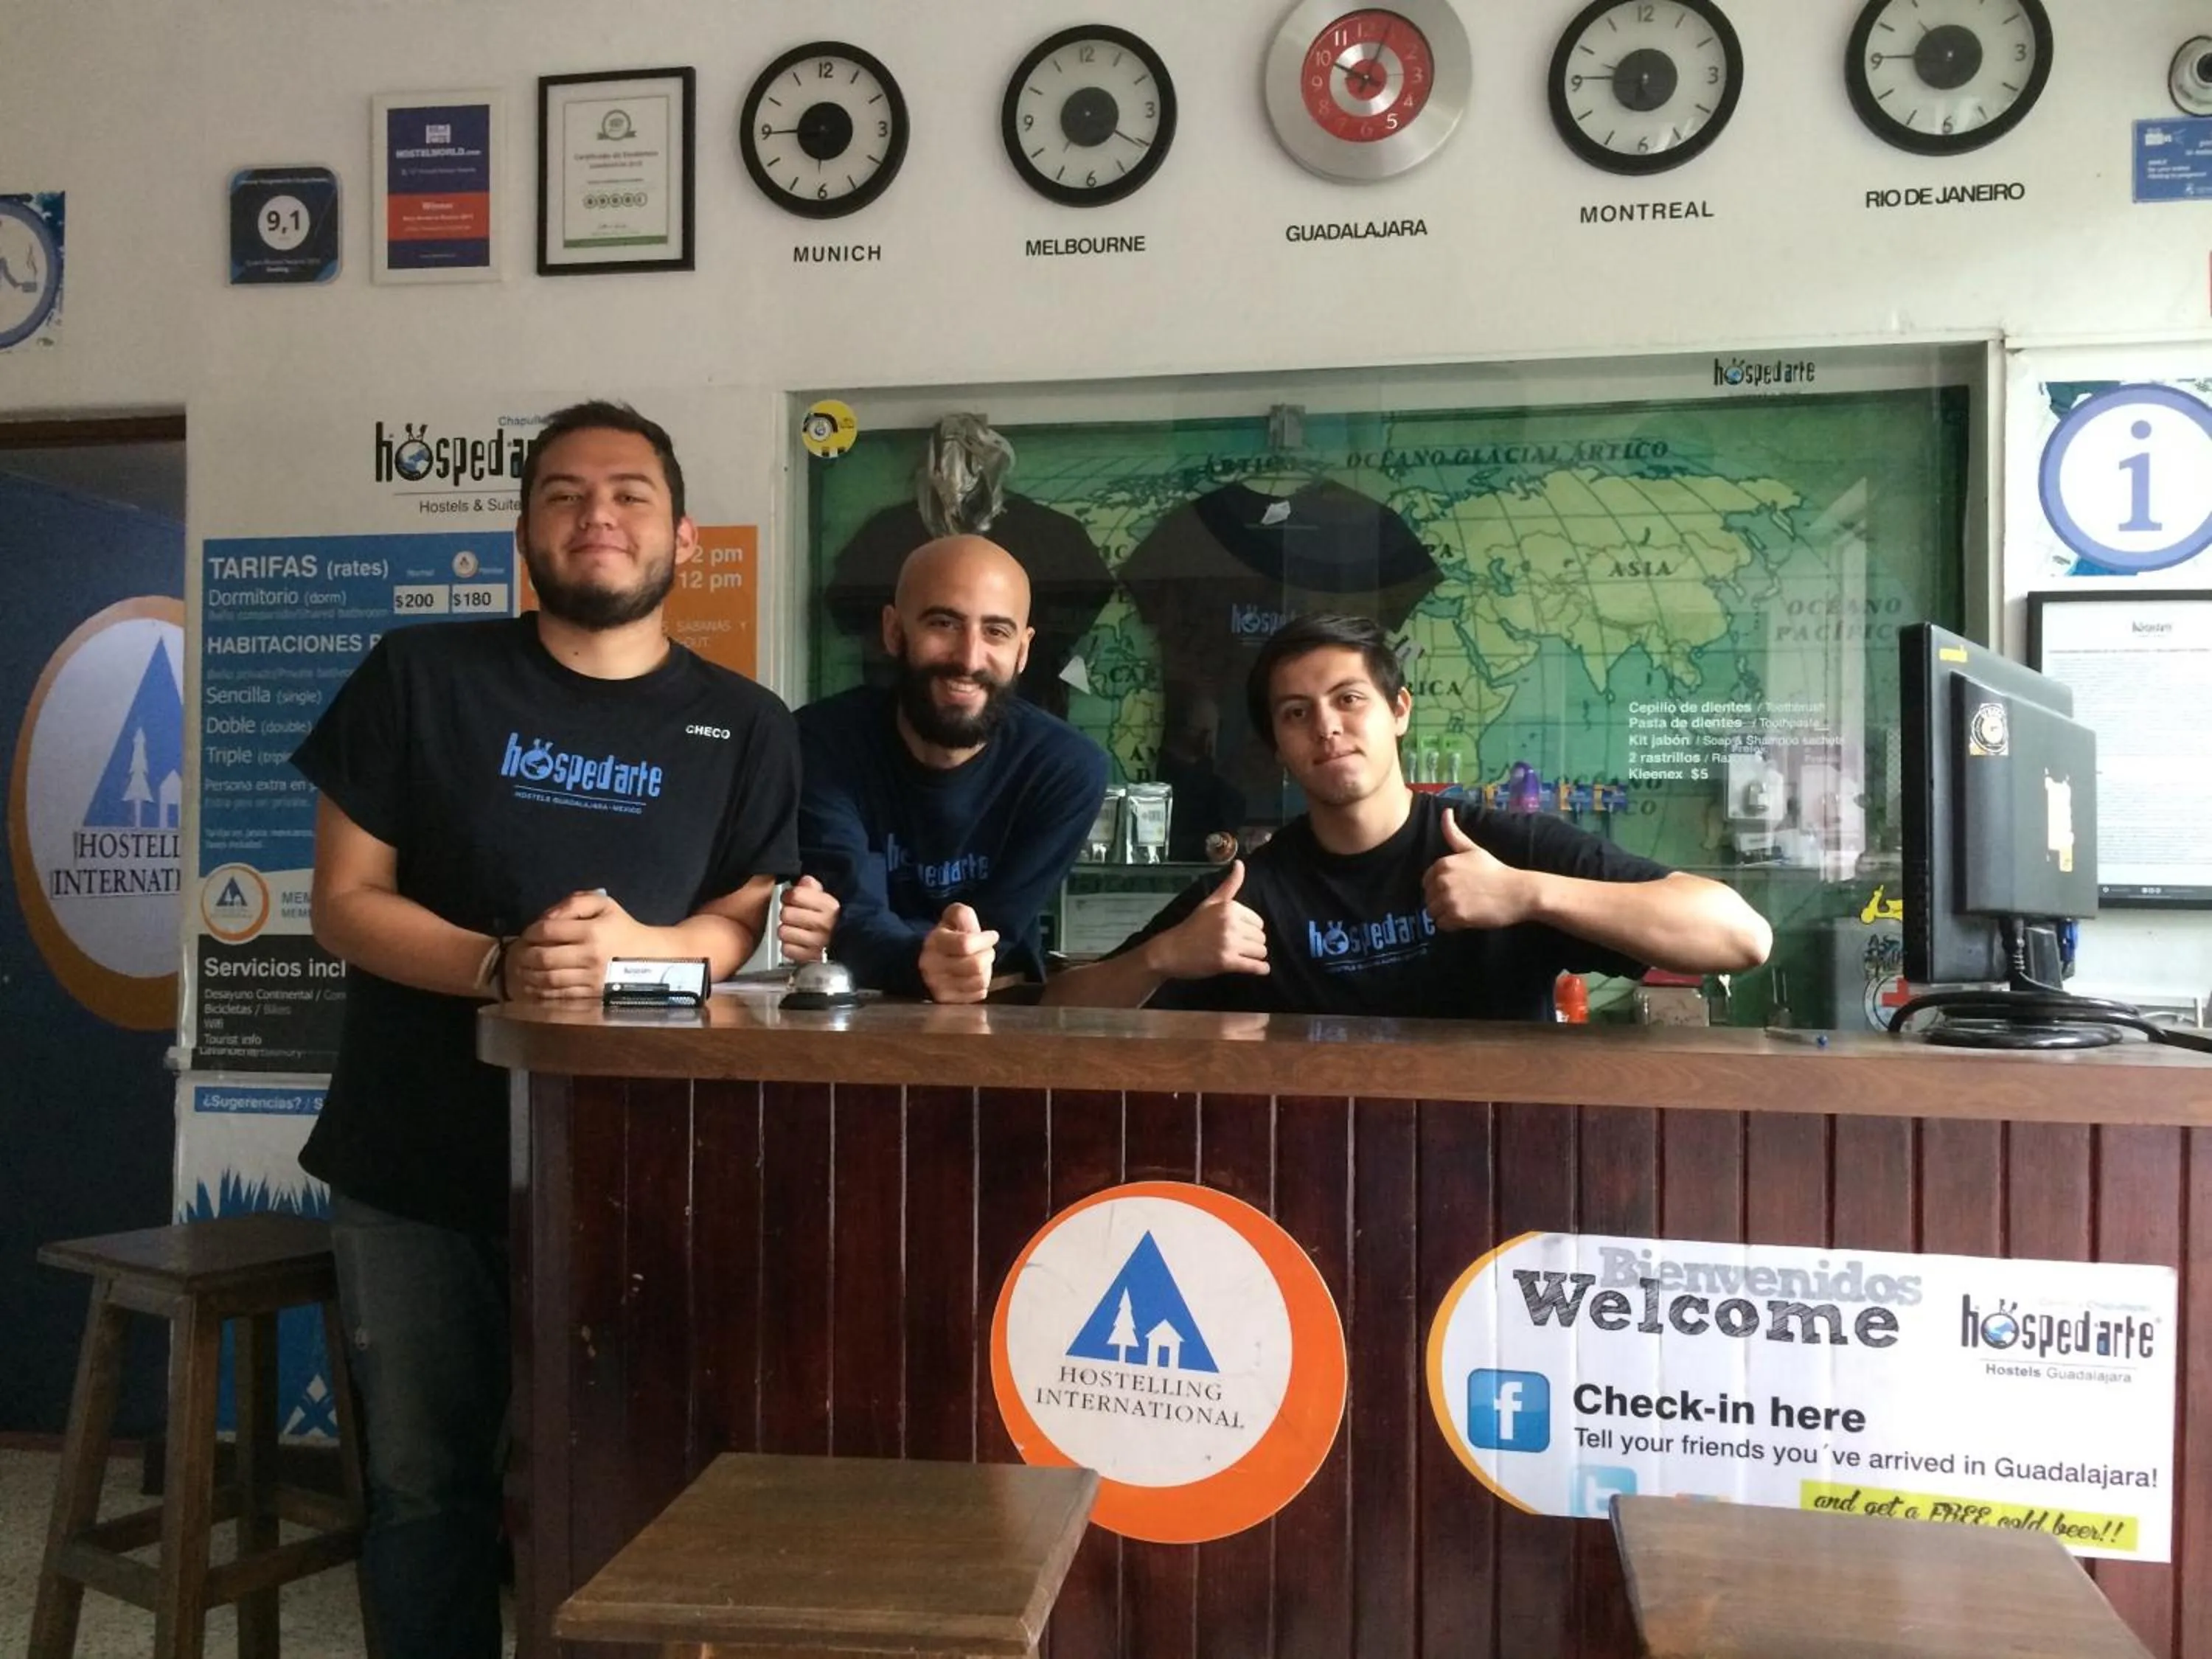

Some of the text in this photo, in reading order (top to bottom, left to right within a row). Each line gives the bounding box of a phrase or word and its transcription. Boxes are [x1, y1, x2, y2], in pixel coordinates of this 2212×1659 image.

[1637, 4, 1655, 24] 12
[1335, 29, 1348, 47] 11
[1079, 45, 1095, 63] 12
[1315, 50, 1332, 67] 10
[1871, 52, 1883, 71] 9
[2014, 43, 2027, 61] 3
[818, 62, 834, 79] 12
[1412, 66, 1423, 84] 3
[1708, 66, 1719, 85] 3
[1312, 76, 1323, 91] 9
[1571, 74, 1583, 92] 9
[1145, 101, 1155, 119] 3
[1404, 94, 1414, 108] 4
[878, 121, 888, 138] 3
[1023, 114, 1034, 132] 9
[1385, 113, 1399, 131] 5
[761, 124, 773, 140] 9
[1638, 136, 1649, 154] 6
[1085, 170, 1097, 188] 6
[817, 183, 827, 200] 6
[1865, 182, 2025, 209] RIO DE JANEIRO
[266, 210, 300, 234] 9,1
[1579, 201, 1714, 224] MONTREAL
[1286, 219, 1428, 243] GUADALAJARA
[793, 245, 881, 262] MUNICH
[1026, 235, 1146, 257] MELBOURNE
[1714, 358, 1815, 386] hospedarte
[420, 499, 469, 514] Hostels
[473, 498, 483, 512] &
[711, 547, 744, 566] pm
[208, 554, 389, 581] TARIFAS (rates)
[1607, 560, 1672, 577] ASIA
[679, 570, 742, 594] 12 pm
[209, 588, 347, 608] Dormitorio (dorm)
[207, 635, 363, 655] HABITACIONES
[206, 686, 323, 706] Sencilla (single)
[1629, 701, 1677, 716] Cepillo
[1680, 701, 1698, 714] de
[1701, 701, 1752, 714] dientes
[206, 717, 313, 736] Doble (double)
[1629, 717, 1667, 728] Pasta
[1670, 717, 1688, 728] de
[1691, 717, 1742, 728] dientes
[685, 725, 731, 740] CHECO
[1629, 735, 1648, 746] Kit
[1651, 734, 1690, 749] jabón
[206, 746, 253, 767] Triple
[501, 732, 662, 797] hospedarte
[1629, 752, 1638, 763] 2
[1641, 751, 1701, 764] rastrillos
[1629, 768, 1709, 781] Kleenex $5
[206, 778, 253, 792] Persona
[204, 957, 301, 978] Servicios
[1599, 1246, 1922, 1307] Bienvenidos
[1513, 1270, 1900, 1349] Welcome
[1961, 1293, 2154, 1359] hospedarte
[1060, 1365, 1223, 1402] HOSTELLING
[1986, 1363, 2132, 1385] Hostels Guadalajara
[1036, 1387, 1245, 1430] INTERNATIONAL
[1573, 1382, 1866, 1434] Check-in here
[1574, 1427, 1613, 1450] Tell
[1621, 1434, 1674, 1456] your
[1681, 1435, 1766, 1460] friends
[1869, 1450, 1955, 1474] arrived
[1964, 1454, 1986, 1475] in
[1994, 1457, 2157, 1490] Guadalajara!
[1814, 1489, 1862, 1514] and
[1905, 1503, 1920, 1519] a
[2053, 1513, 2125, 1543] beer!!
